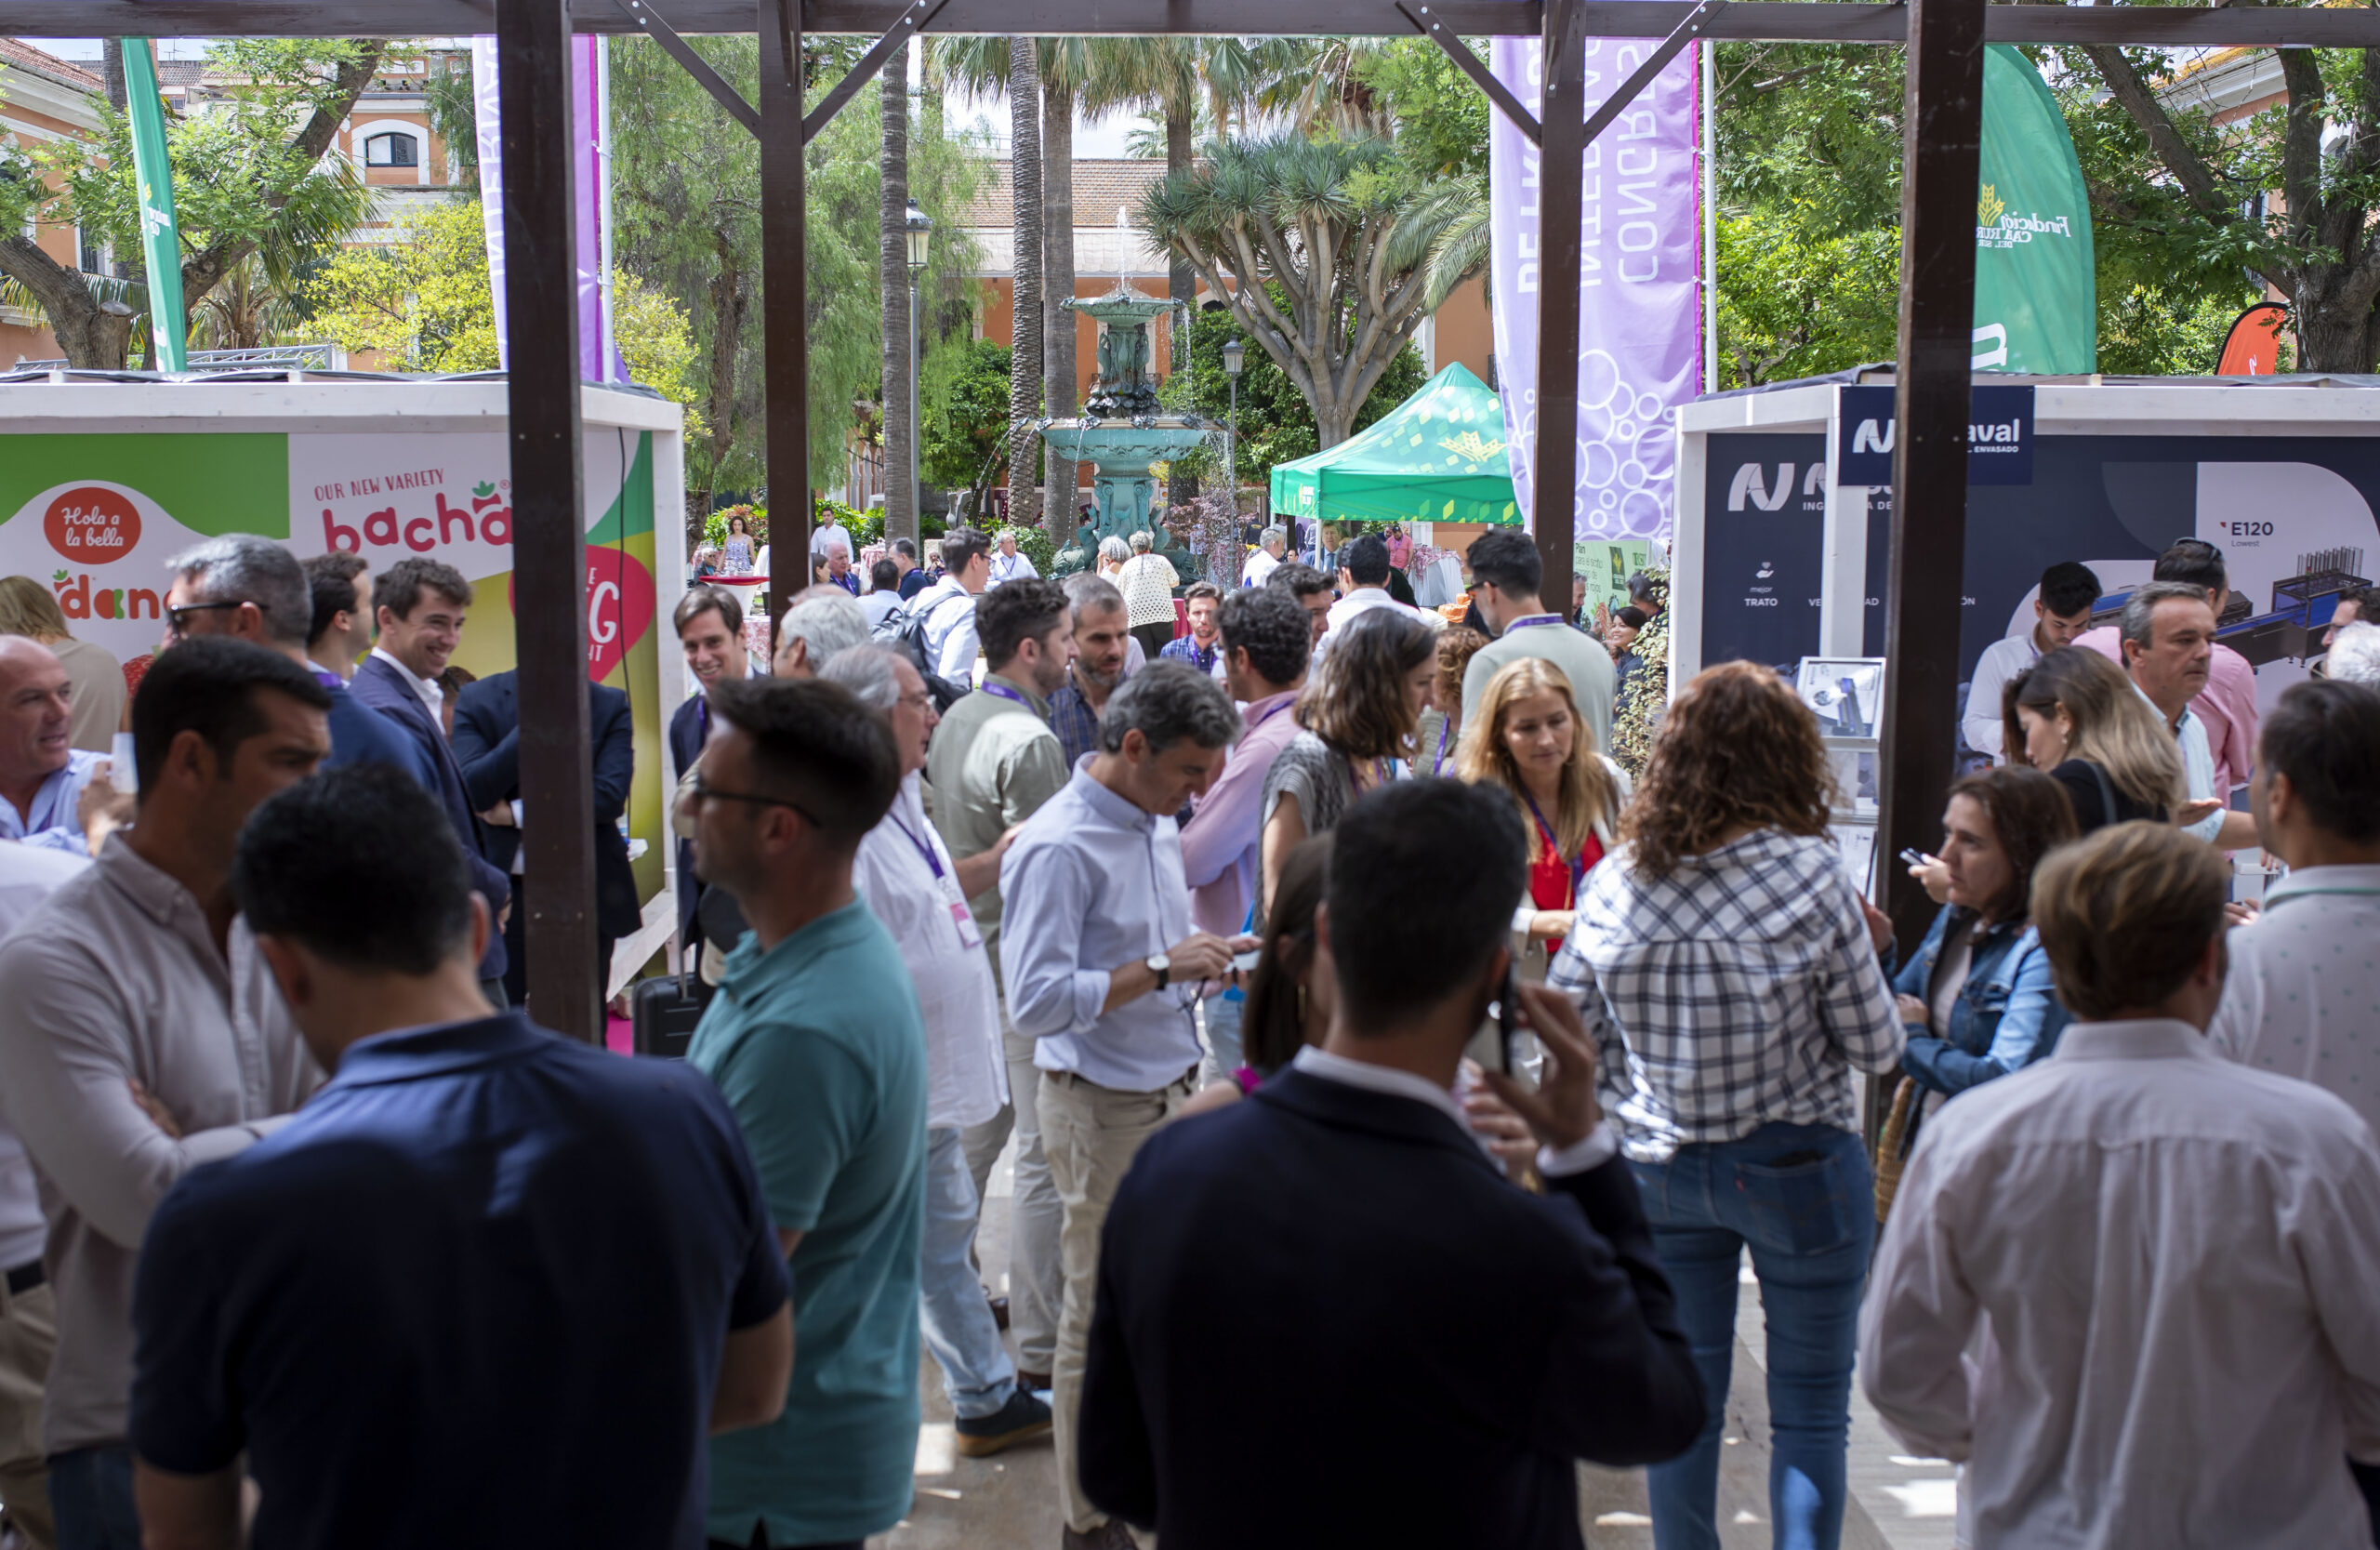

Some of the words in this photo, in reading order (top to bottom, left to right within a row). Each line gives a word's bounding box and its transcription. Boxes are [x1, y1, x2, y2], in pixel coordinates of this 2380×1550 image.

[314, 483, 345, 501] OUR
[350, 476, 380, 497] NEW
[385, 468, 444, 491] VARIETY
[61, 506, 105, 525] Hola
[111, 514, 120, 525] a
[65, 527, 81, 547] la
[86, 527, 124, 547] bella
[2231, 522, 2274, 537] E120
[1744, 598, 1778, 607] TRATO
